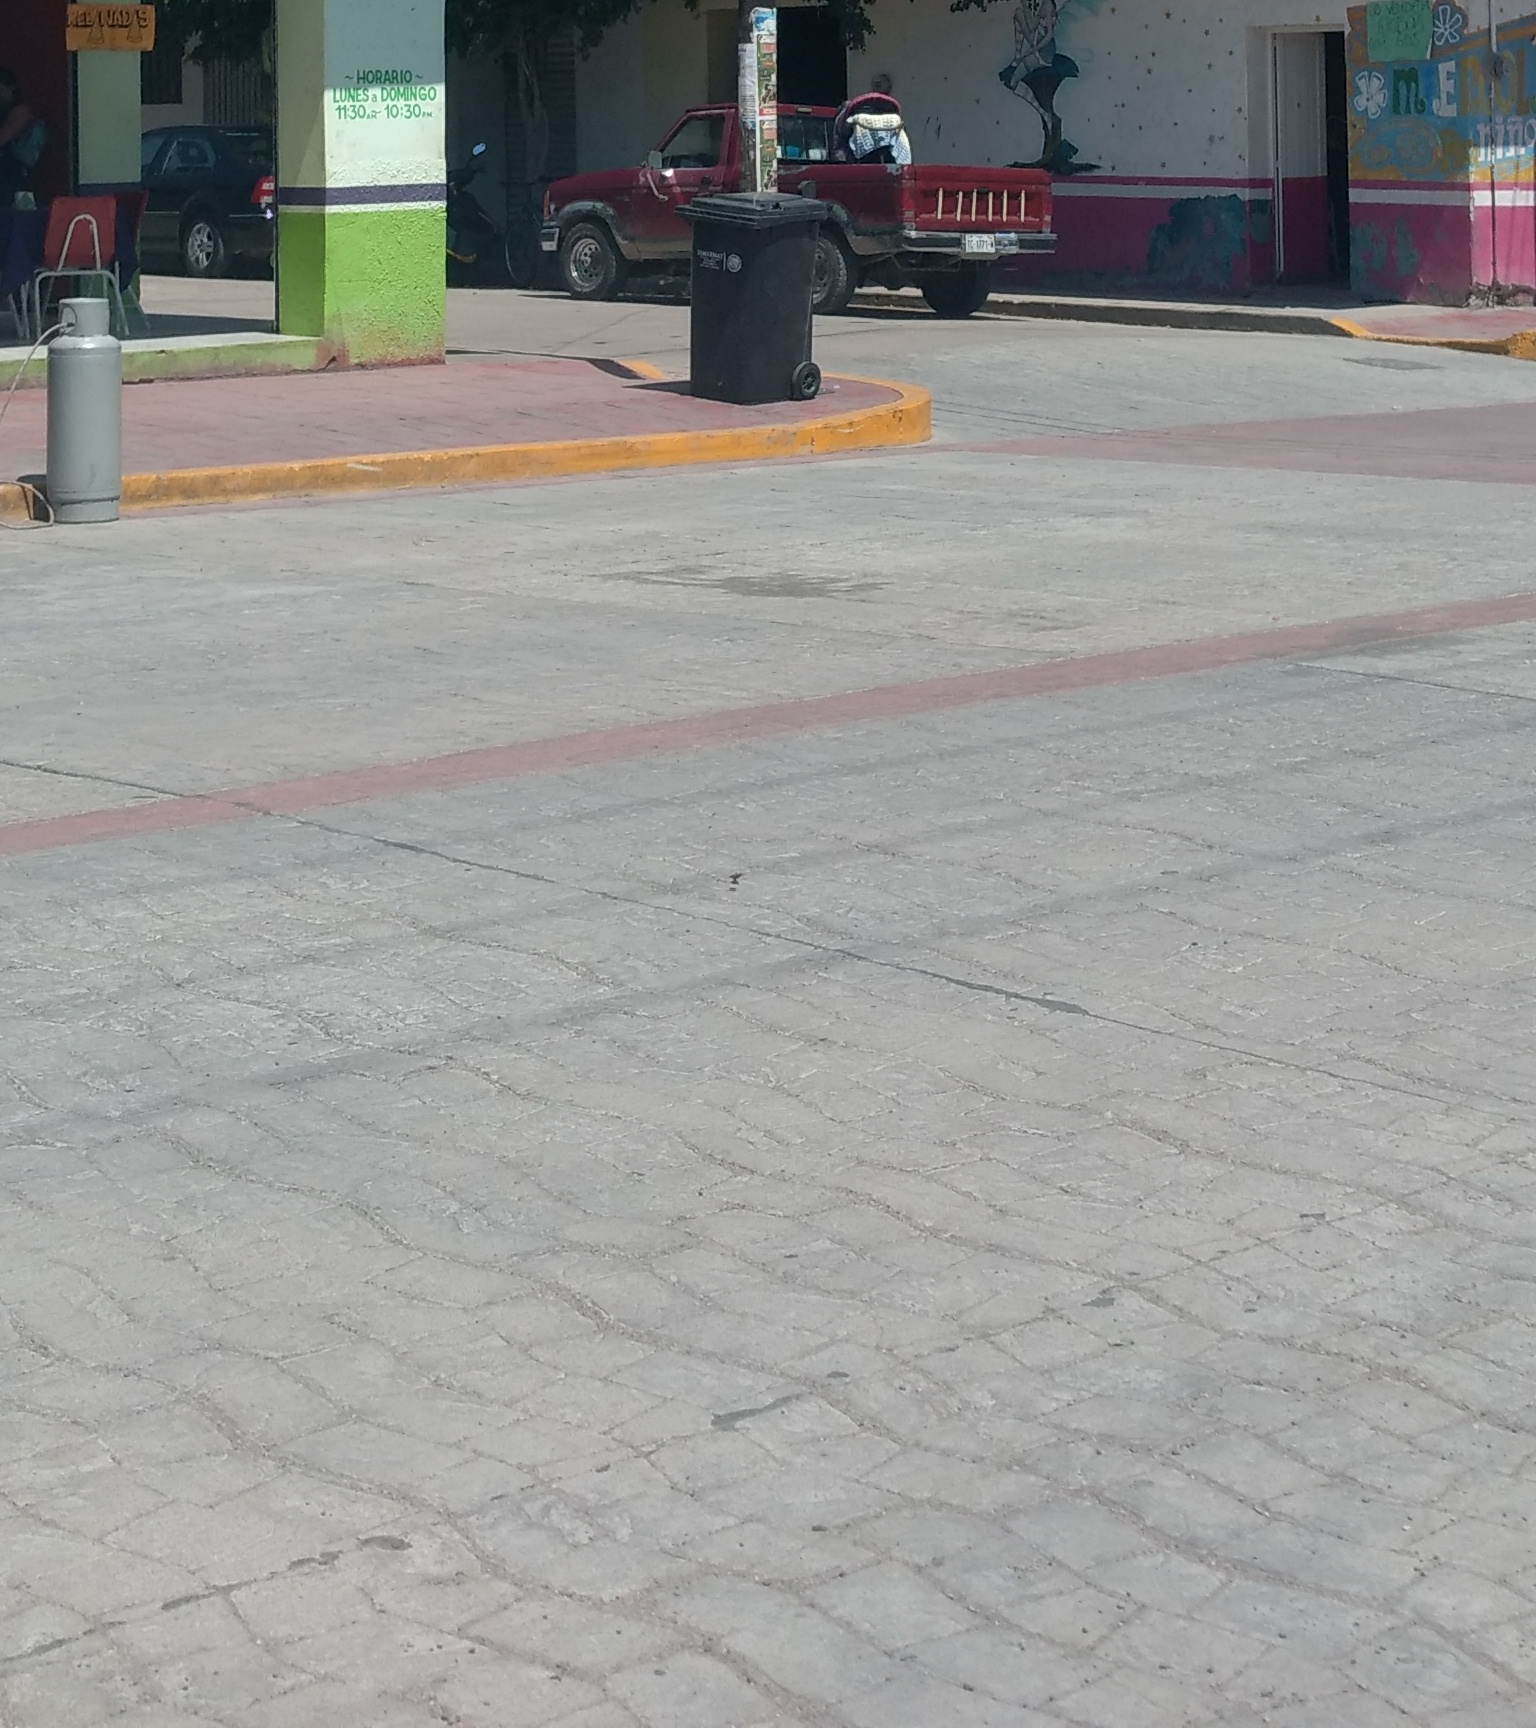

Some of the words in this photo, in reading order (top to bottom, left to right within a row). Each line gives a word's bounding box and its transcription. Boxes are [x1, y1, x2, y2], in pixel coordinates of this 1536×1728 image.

[356, 69, 413, 84] HORARIO
[332, 86, 370, 103] LUNES
[371, 93, 378, 103] a
[380, 86, 437, 102] DOMINGO
